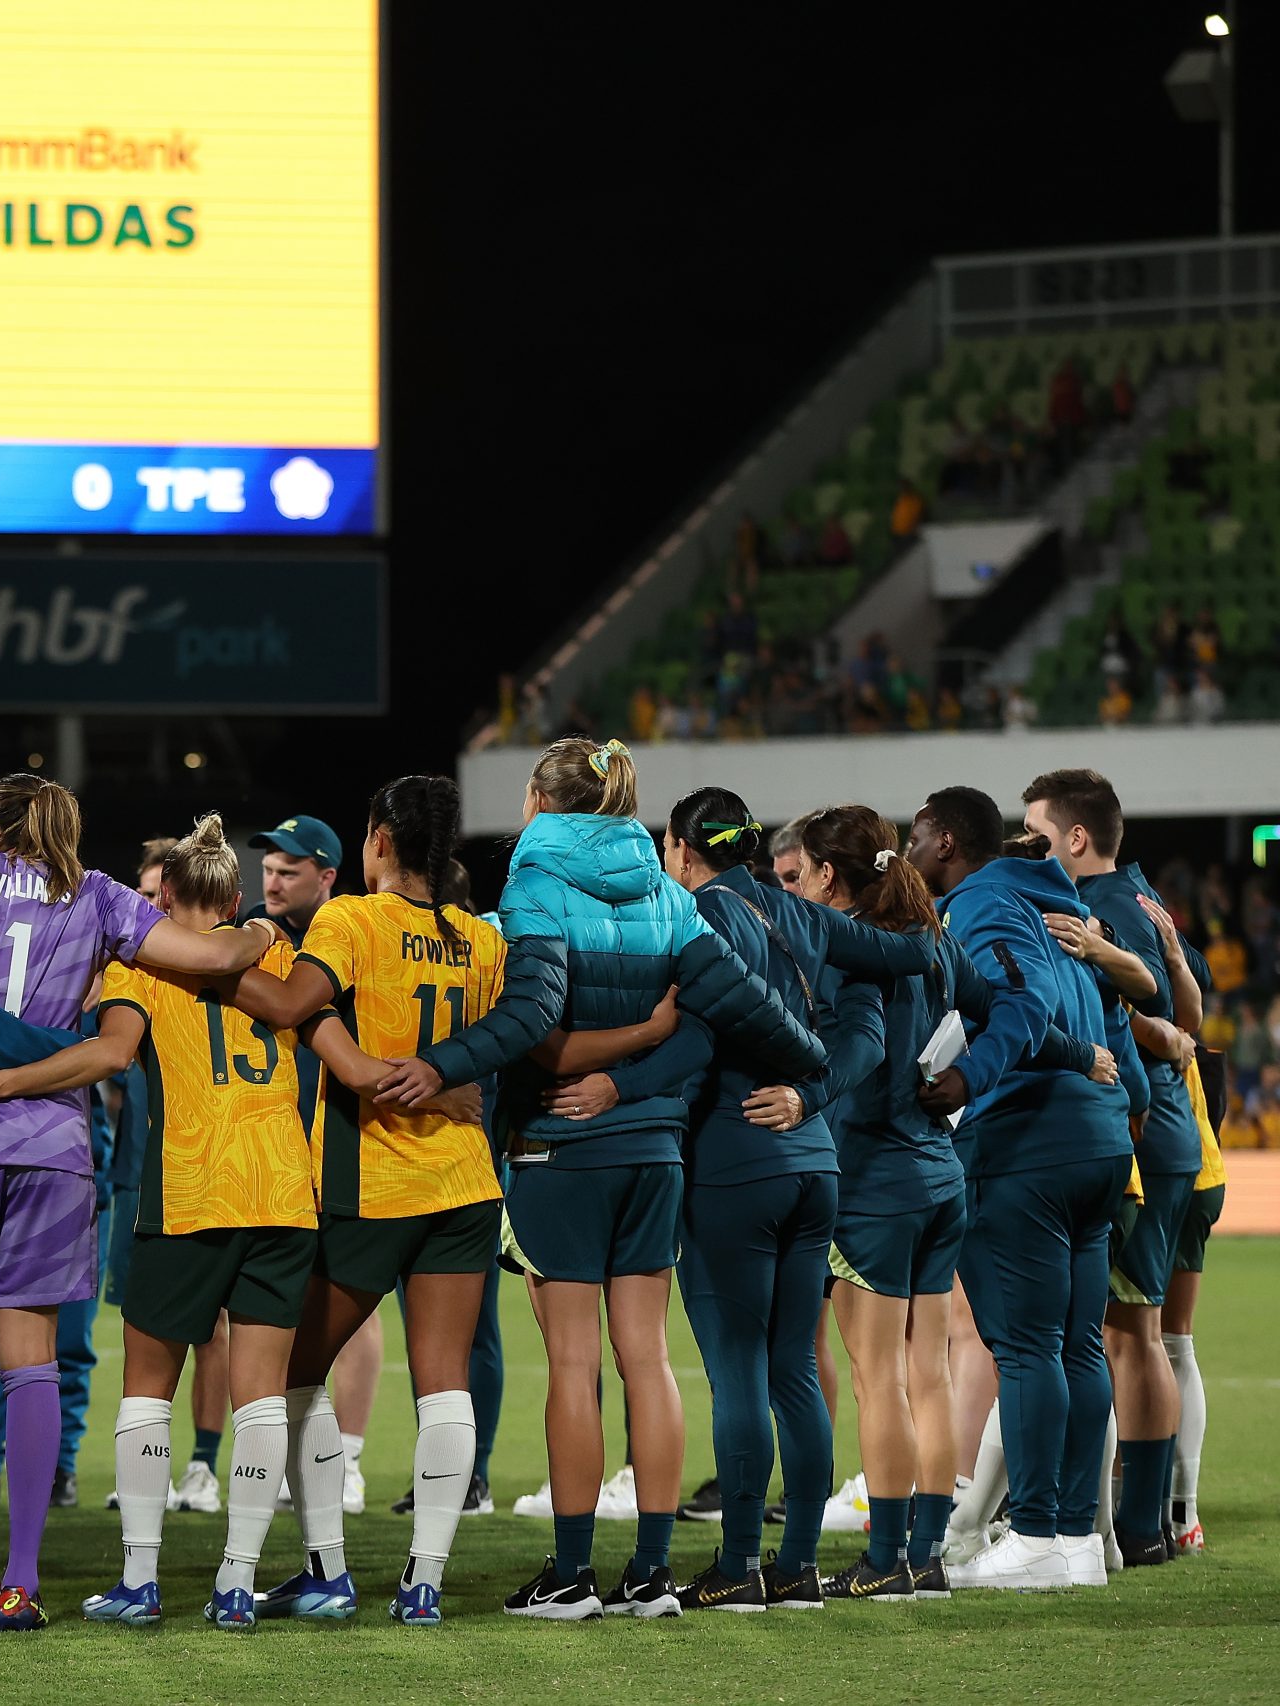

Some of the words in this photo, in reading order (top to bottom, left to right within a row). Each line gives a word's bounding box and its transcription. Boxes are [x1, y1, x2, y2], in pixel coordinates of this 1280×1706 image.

[72, 462, 113, 511] 0
[136, 466, 247, 513] TPE
[4, 921, 32, 1019] 1
[401, 931, 472, 969] FOWLER
[195, 987, 278, 1086] 13
[410, 983, 466, 1052] 11
[141, 1444, 170, 1458] AUS
[234, 1465, 267, 1480] AUS
